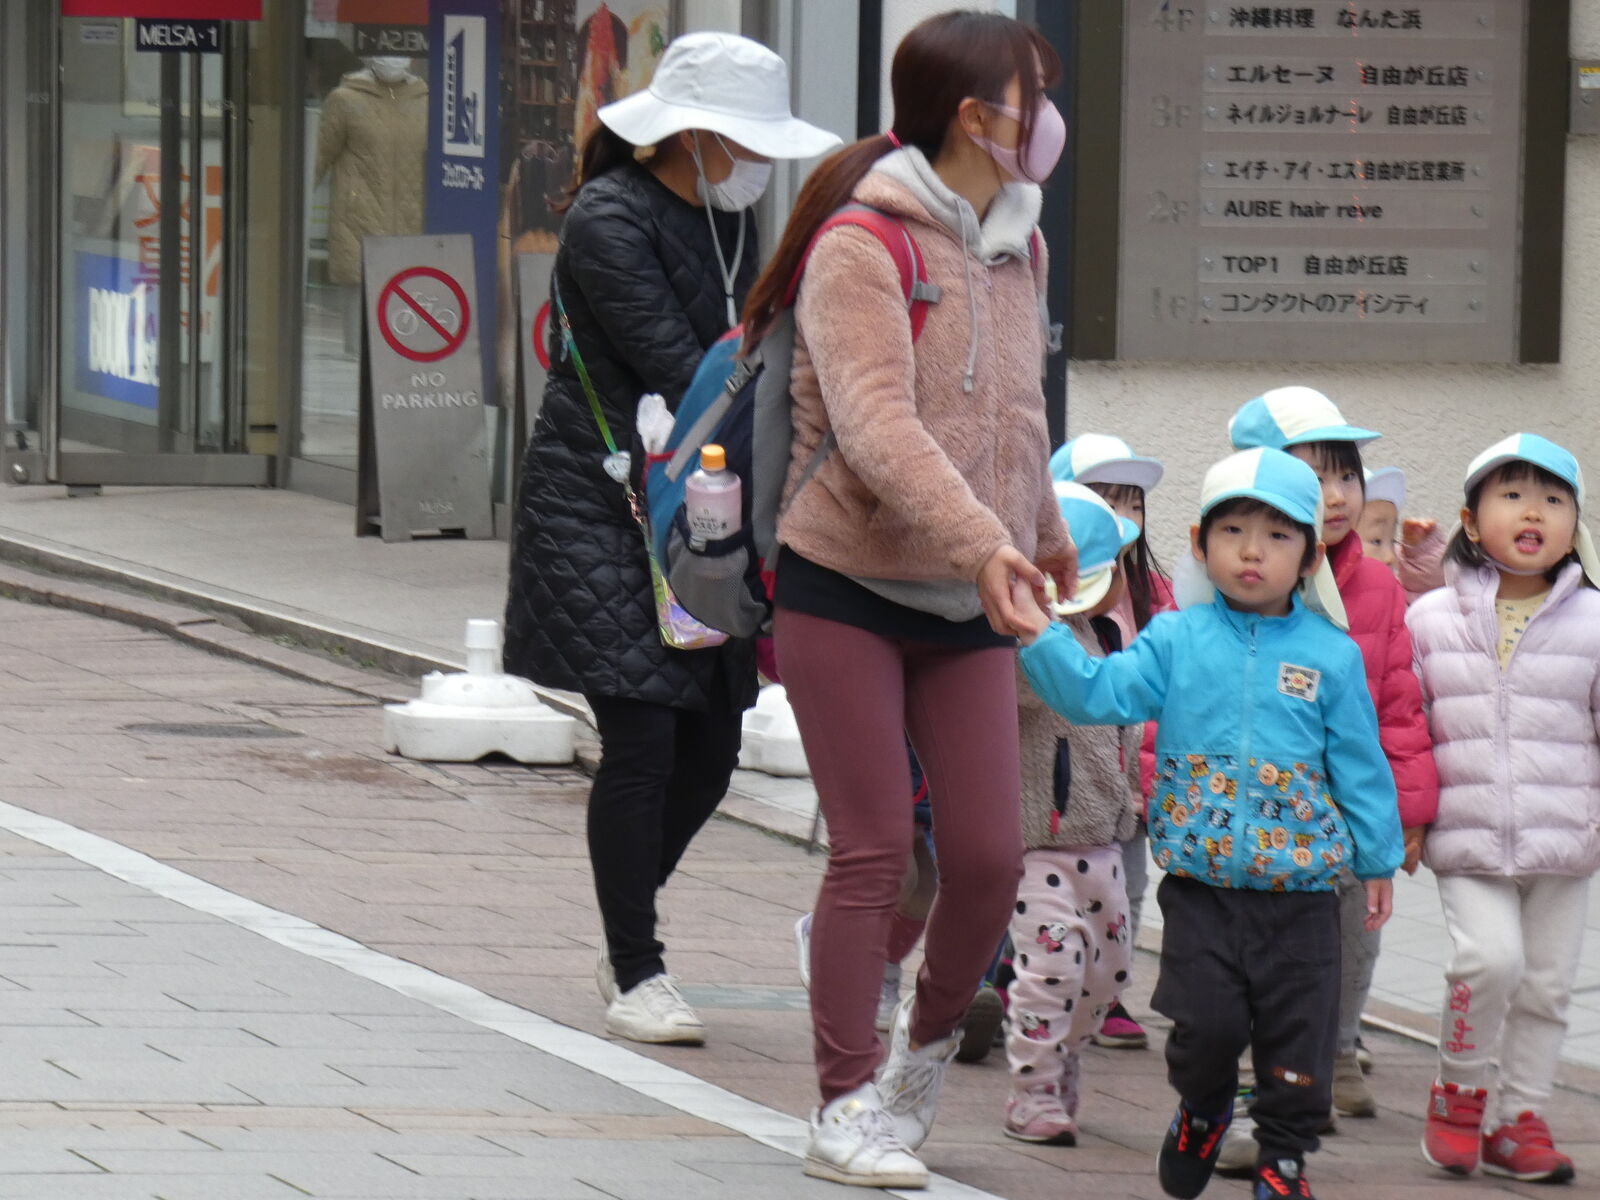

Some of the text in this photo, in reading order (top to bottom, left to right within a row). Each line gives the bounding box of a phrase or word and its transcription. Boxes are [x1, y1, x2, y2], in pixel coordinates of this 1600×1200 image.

[1229, 7, 1422, 29] 沖縄料理 なんた浜
[1227, 65, 1469, 86] エルセーヌ 自由が丘店
[1226, 104, 1468, 126] ネイルジョルナーレ 自由が丘店
[1224, 199, 1383, 218] AUBE hair reve
[1222, 255, 1408, 275] TOP1 自由が丘店
[1221, 292, 1429, 315] コンタクトのアイシティ
[411, 372, 446, 388] NO
[382, 391, 479, 410] PARKING
